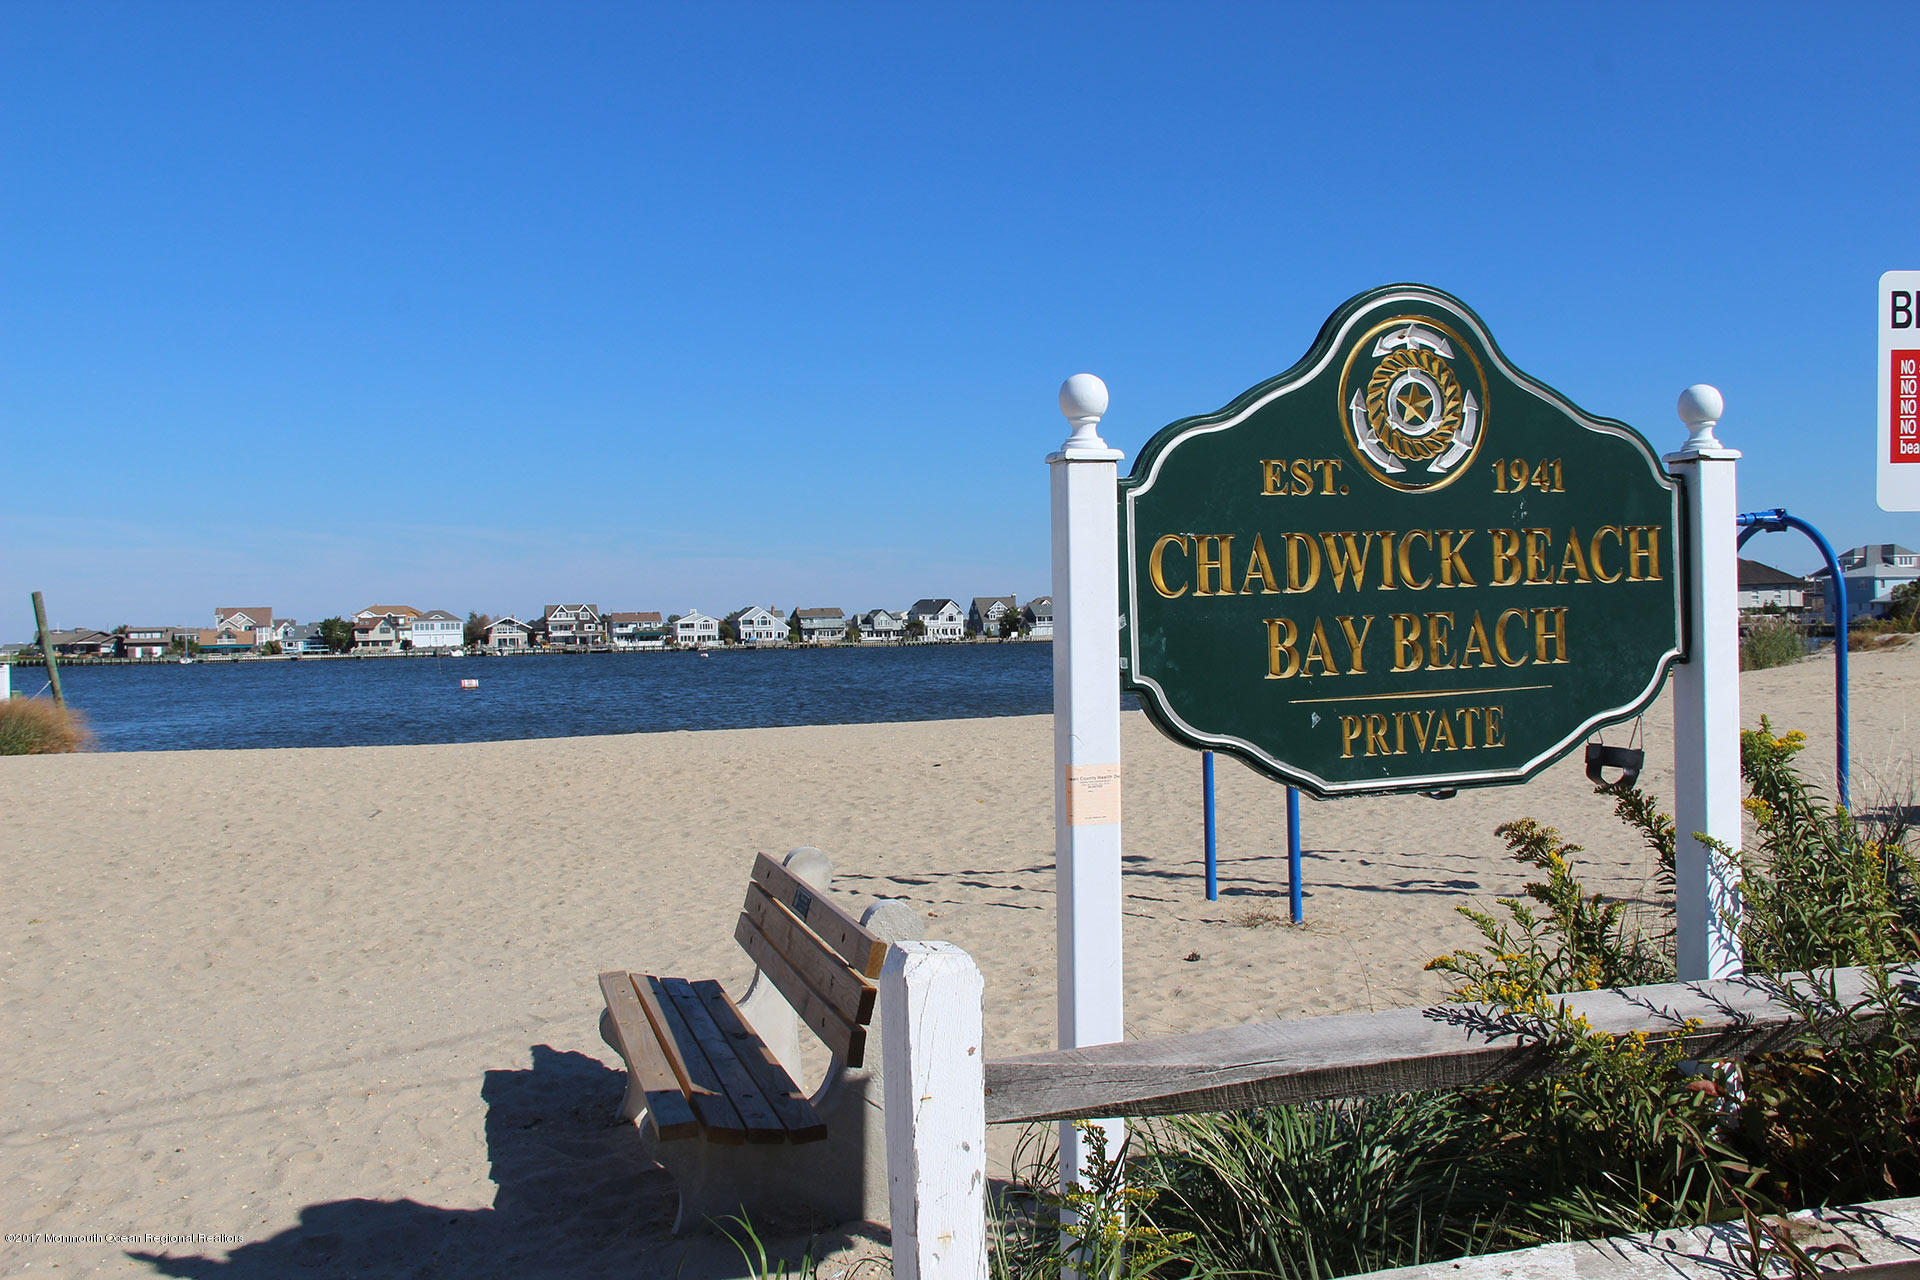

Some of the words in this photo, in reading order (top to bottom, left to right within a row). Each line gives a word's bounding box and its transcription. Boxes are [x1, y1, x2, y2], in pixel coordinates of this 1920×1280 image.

[1900, 359, 1916, 375] NO
[1900, 379, 1917, 395] NO
[1900, 399, 1917, 414] NO
[1900, 419, 1917, 434] NO
[1260, 458, 1349, 496] EST.
[1492, 457, 1566, 493] 1941
[1148, 527, 1477, 598] CHADWICK
[1488, 524, 1663, 586] BEACH
[1263, 613, 1375, 680] BAY
[1389, 606, 1570, 673] BEACH
[1339, 705, 1505, 759] PRIVATE
